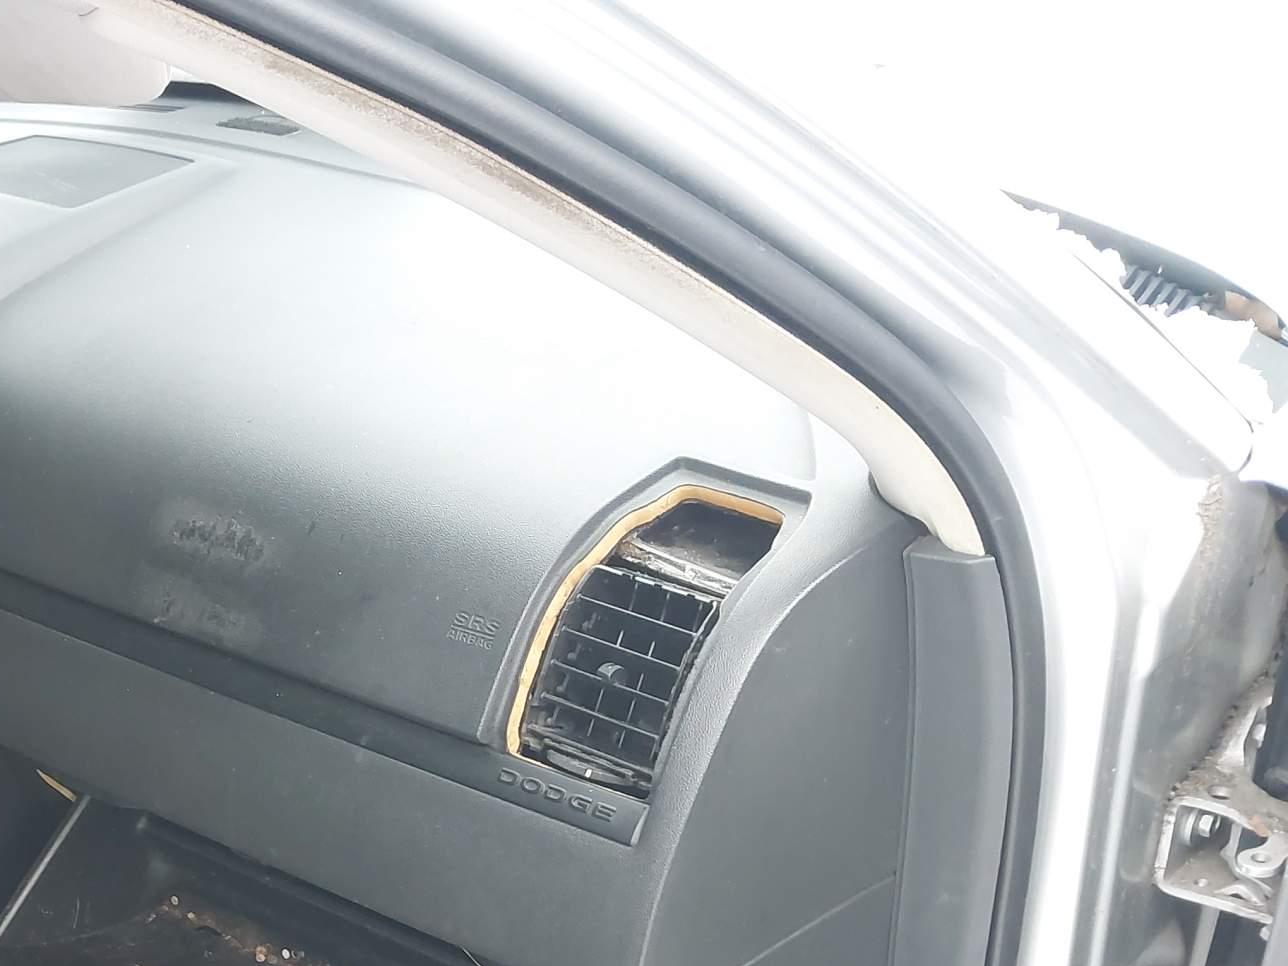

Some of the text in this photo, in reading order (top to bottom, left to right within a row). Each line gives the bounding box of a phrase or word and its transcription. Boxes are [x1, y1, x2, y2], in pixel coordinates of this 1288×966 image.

[453, 610, 500, 635] SRS
[446, 629, 494, 650] AIRBAG
[497, 767, 617, 822] DODGE
